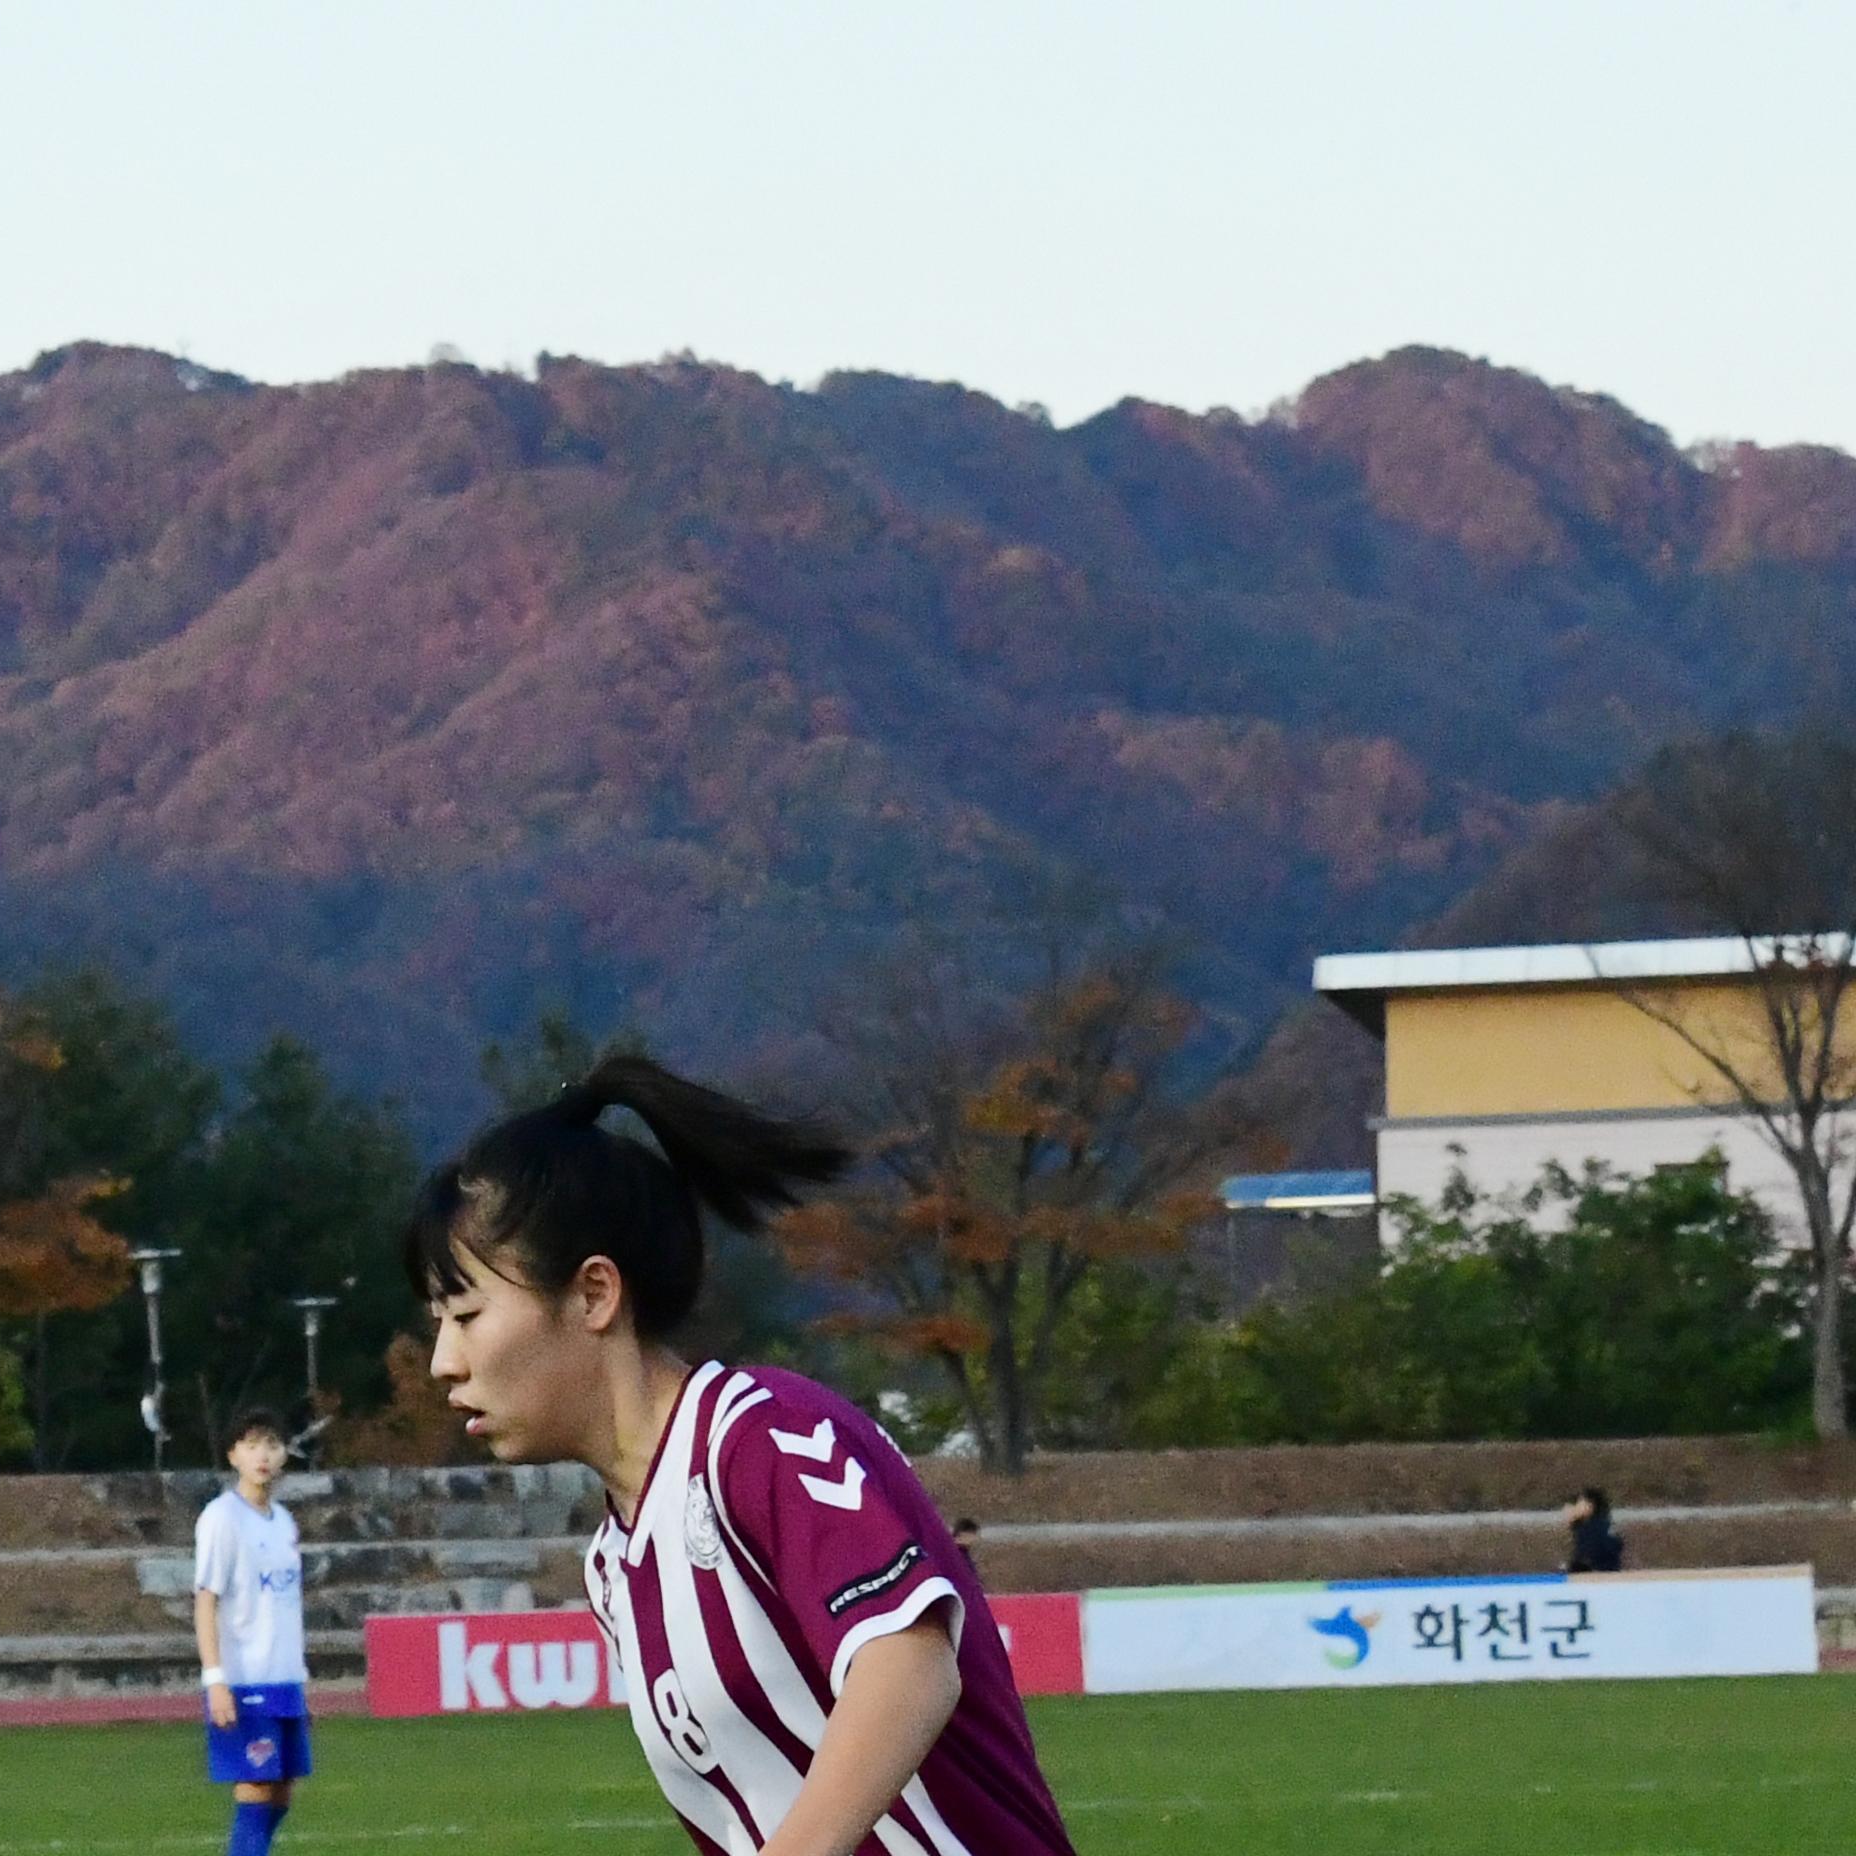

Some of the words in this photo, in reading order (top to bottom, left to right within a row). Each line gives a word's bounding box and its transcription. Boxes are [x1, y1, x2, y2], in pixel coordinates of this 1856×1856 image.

[830, 1545, 920, 1612] RESPECT
[438, 1622, 630, 1711] kw
[1412, 1599, 1595, 1661] 화천군
[654, 1668, 719, 1775] 8
